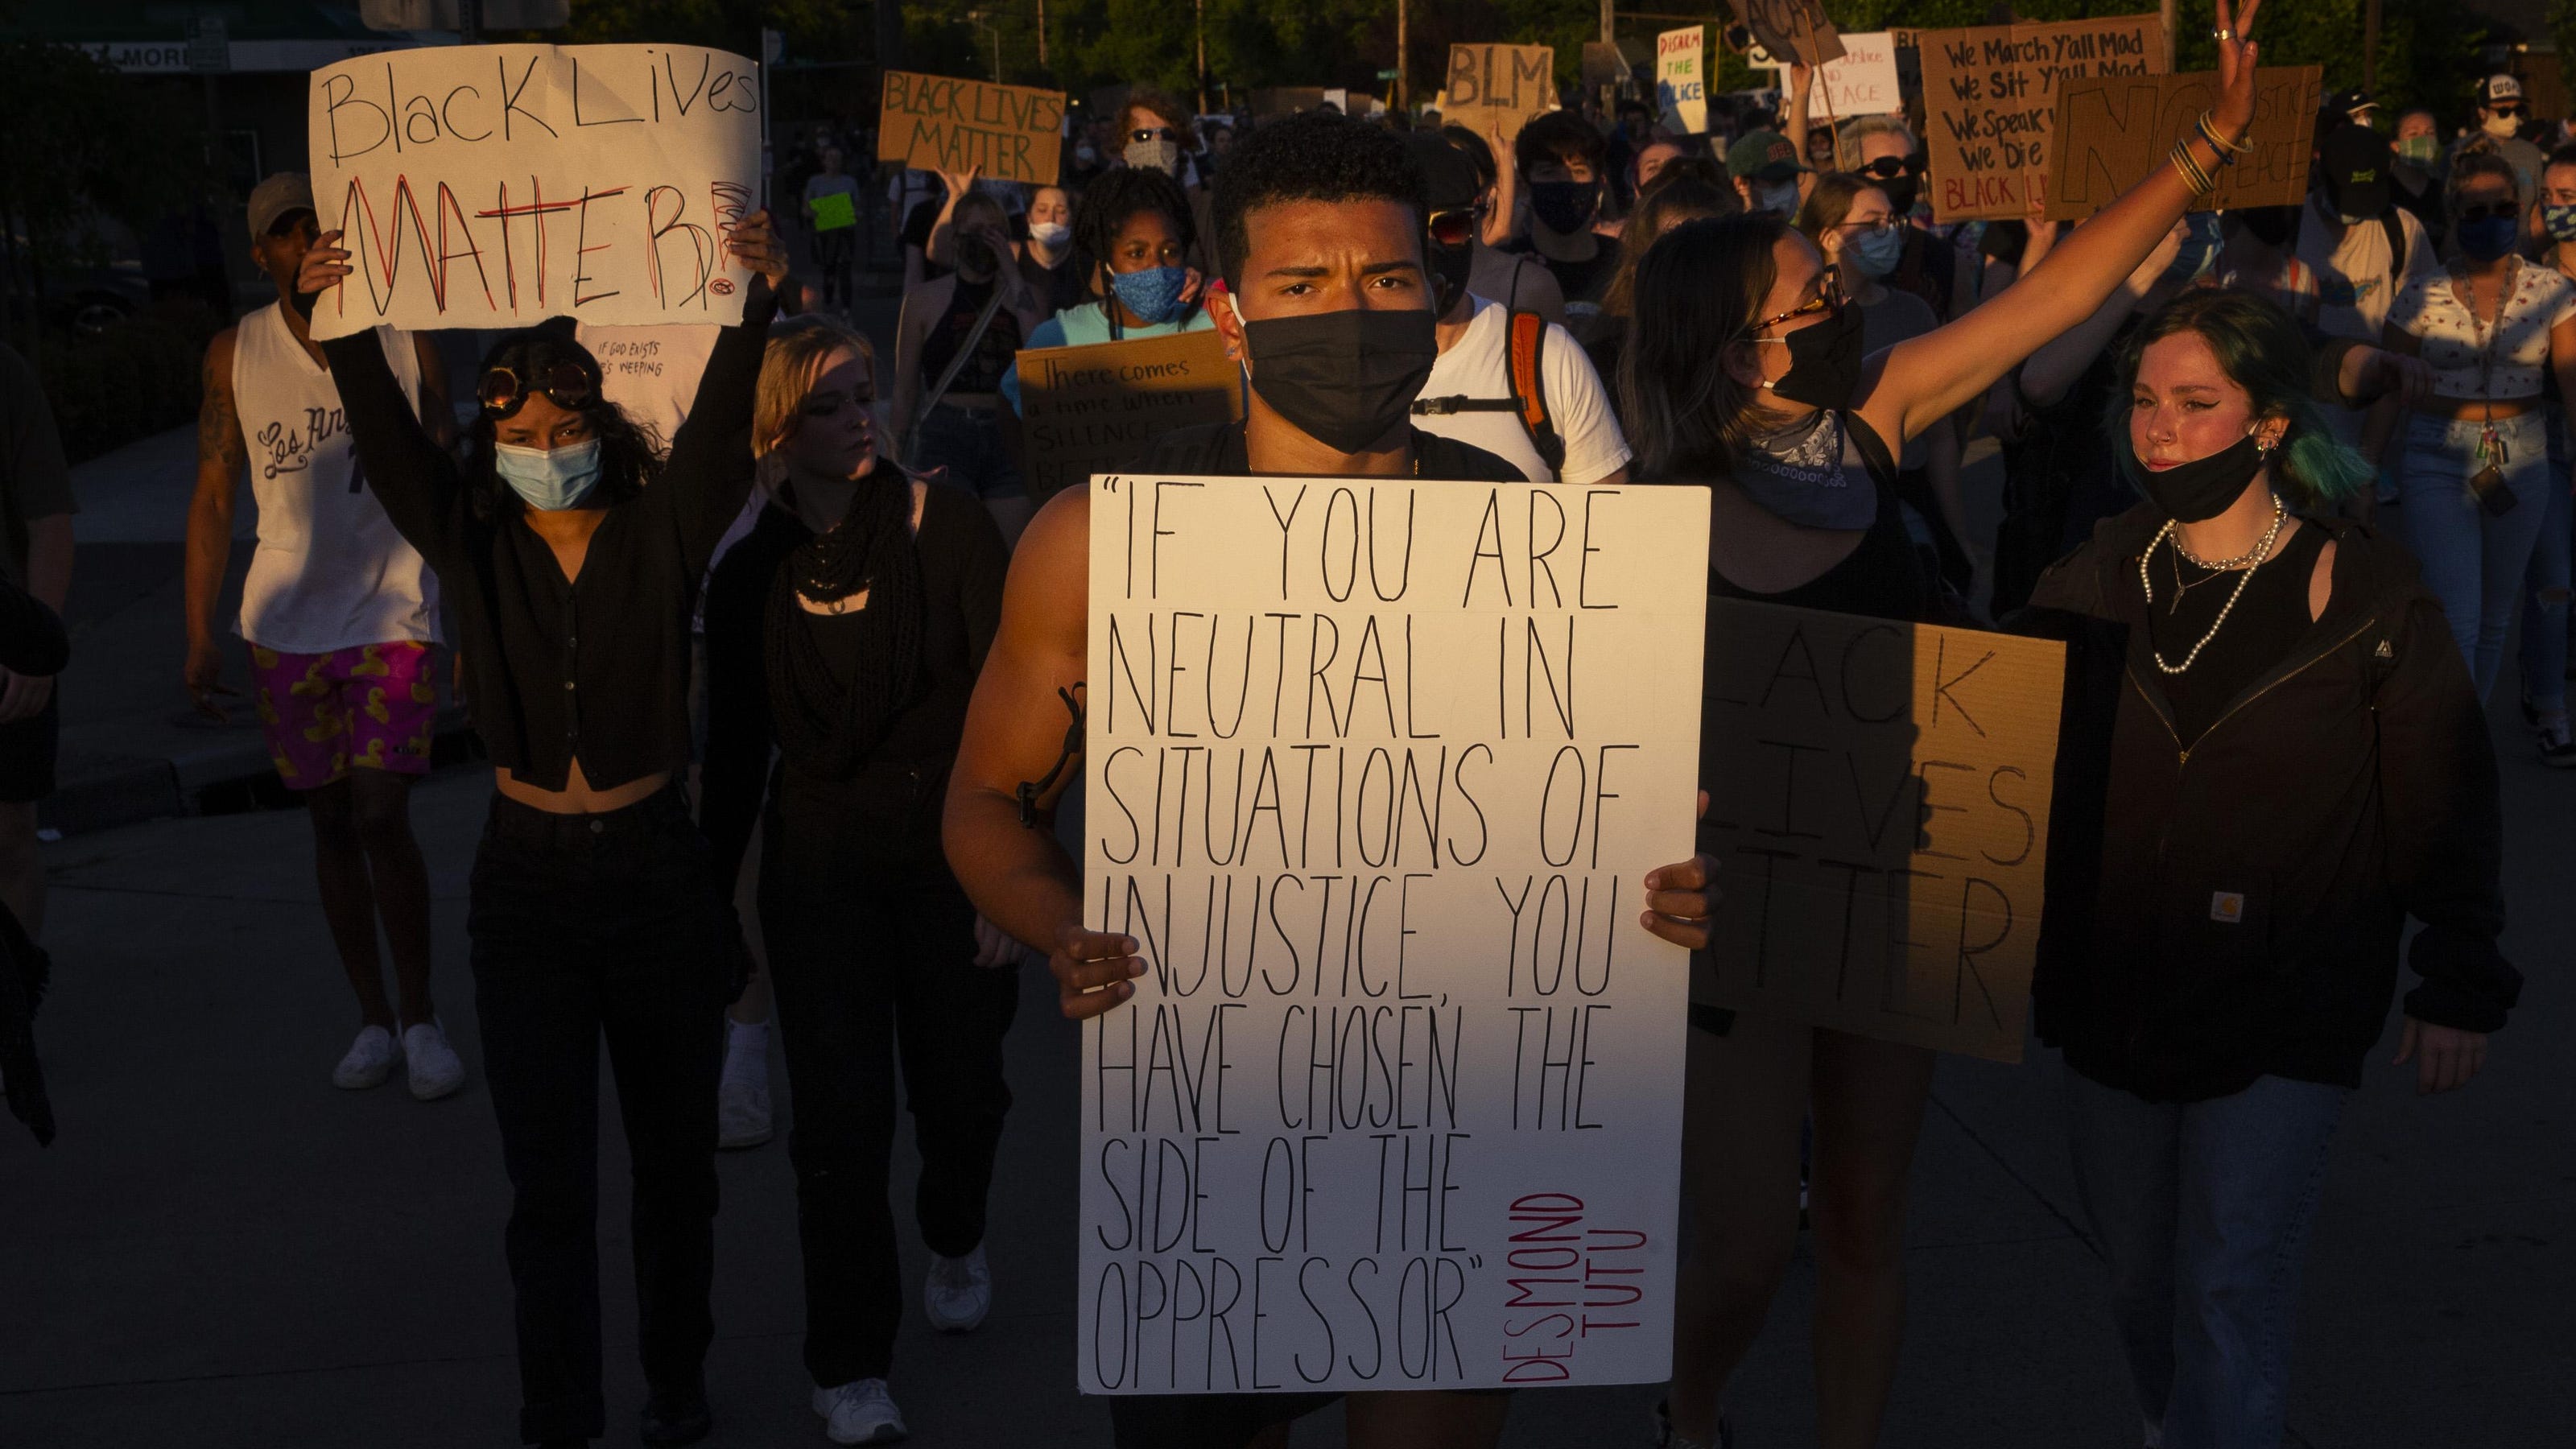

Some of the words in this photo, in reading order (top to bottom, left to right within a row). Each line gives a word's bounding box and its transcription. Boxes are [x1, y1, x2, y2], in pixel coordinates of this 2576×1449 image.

[1447, 47, 1549, 109] BLM
[1666, 59, 1693, 75] THE
[1944, 42, 1976, 68] We
[1983, 37, 2050, 65] March
[2098, 28, 2143, 57] Mad
[886, 72, 965, 122] BLACK
[974, 83, 1063, 132] LIVES
[1950, 76, 1982, 100] We
[1990, 71, 2029, 98] Sit
[907, 118, 1034, 181] MATTER
[1942, 109, 1978, 141] We
[1959, 147, 1995, 171] We
[2003, 141, 2042, 169] Die
[1946, 176, 2016, 210] BLACK
[598, 341, 609, 355] IF
[609, 341, 627, 356] GOD
[629, 341, 661, 359] EXISTS
[619, 361, 663, 378] WEEPING
[1027, 357, 1113, 391] There
[1119, 359, 1191, 382] comes
[1263, 484, 1415, 603] YOU
[1463, 488, 1620, 609] ARE
[1108, 612, 1440, 739] NEUTRAL
[1500, 614, 1575, 740] IN
[1705, 621, 1996, 737] ACK
[1101, 744, 1493, 870] SITUATIONS
[1539, 745, 1640, 870] OF
[1495, 875, 1618, 997] YOU
[1710, 846, 2013, 1030] TTER
[1097, 1004, 1247, 1134] HAVE
[1278, 1004, 1462, 1131] CHOSEN
[1507, 1004, 1612, 1132] THE
[1097, 1137, 1220, 1253] SIDE
[1260, 1136, 1329, 1254] OF
[1369, 1133, 1472, 1253] THE
[1502, 1192, 1584, 1383] DESMOND
[1581, 1228, 1647, 1338] TUTU
